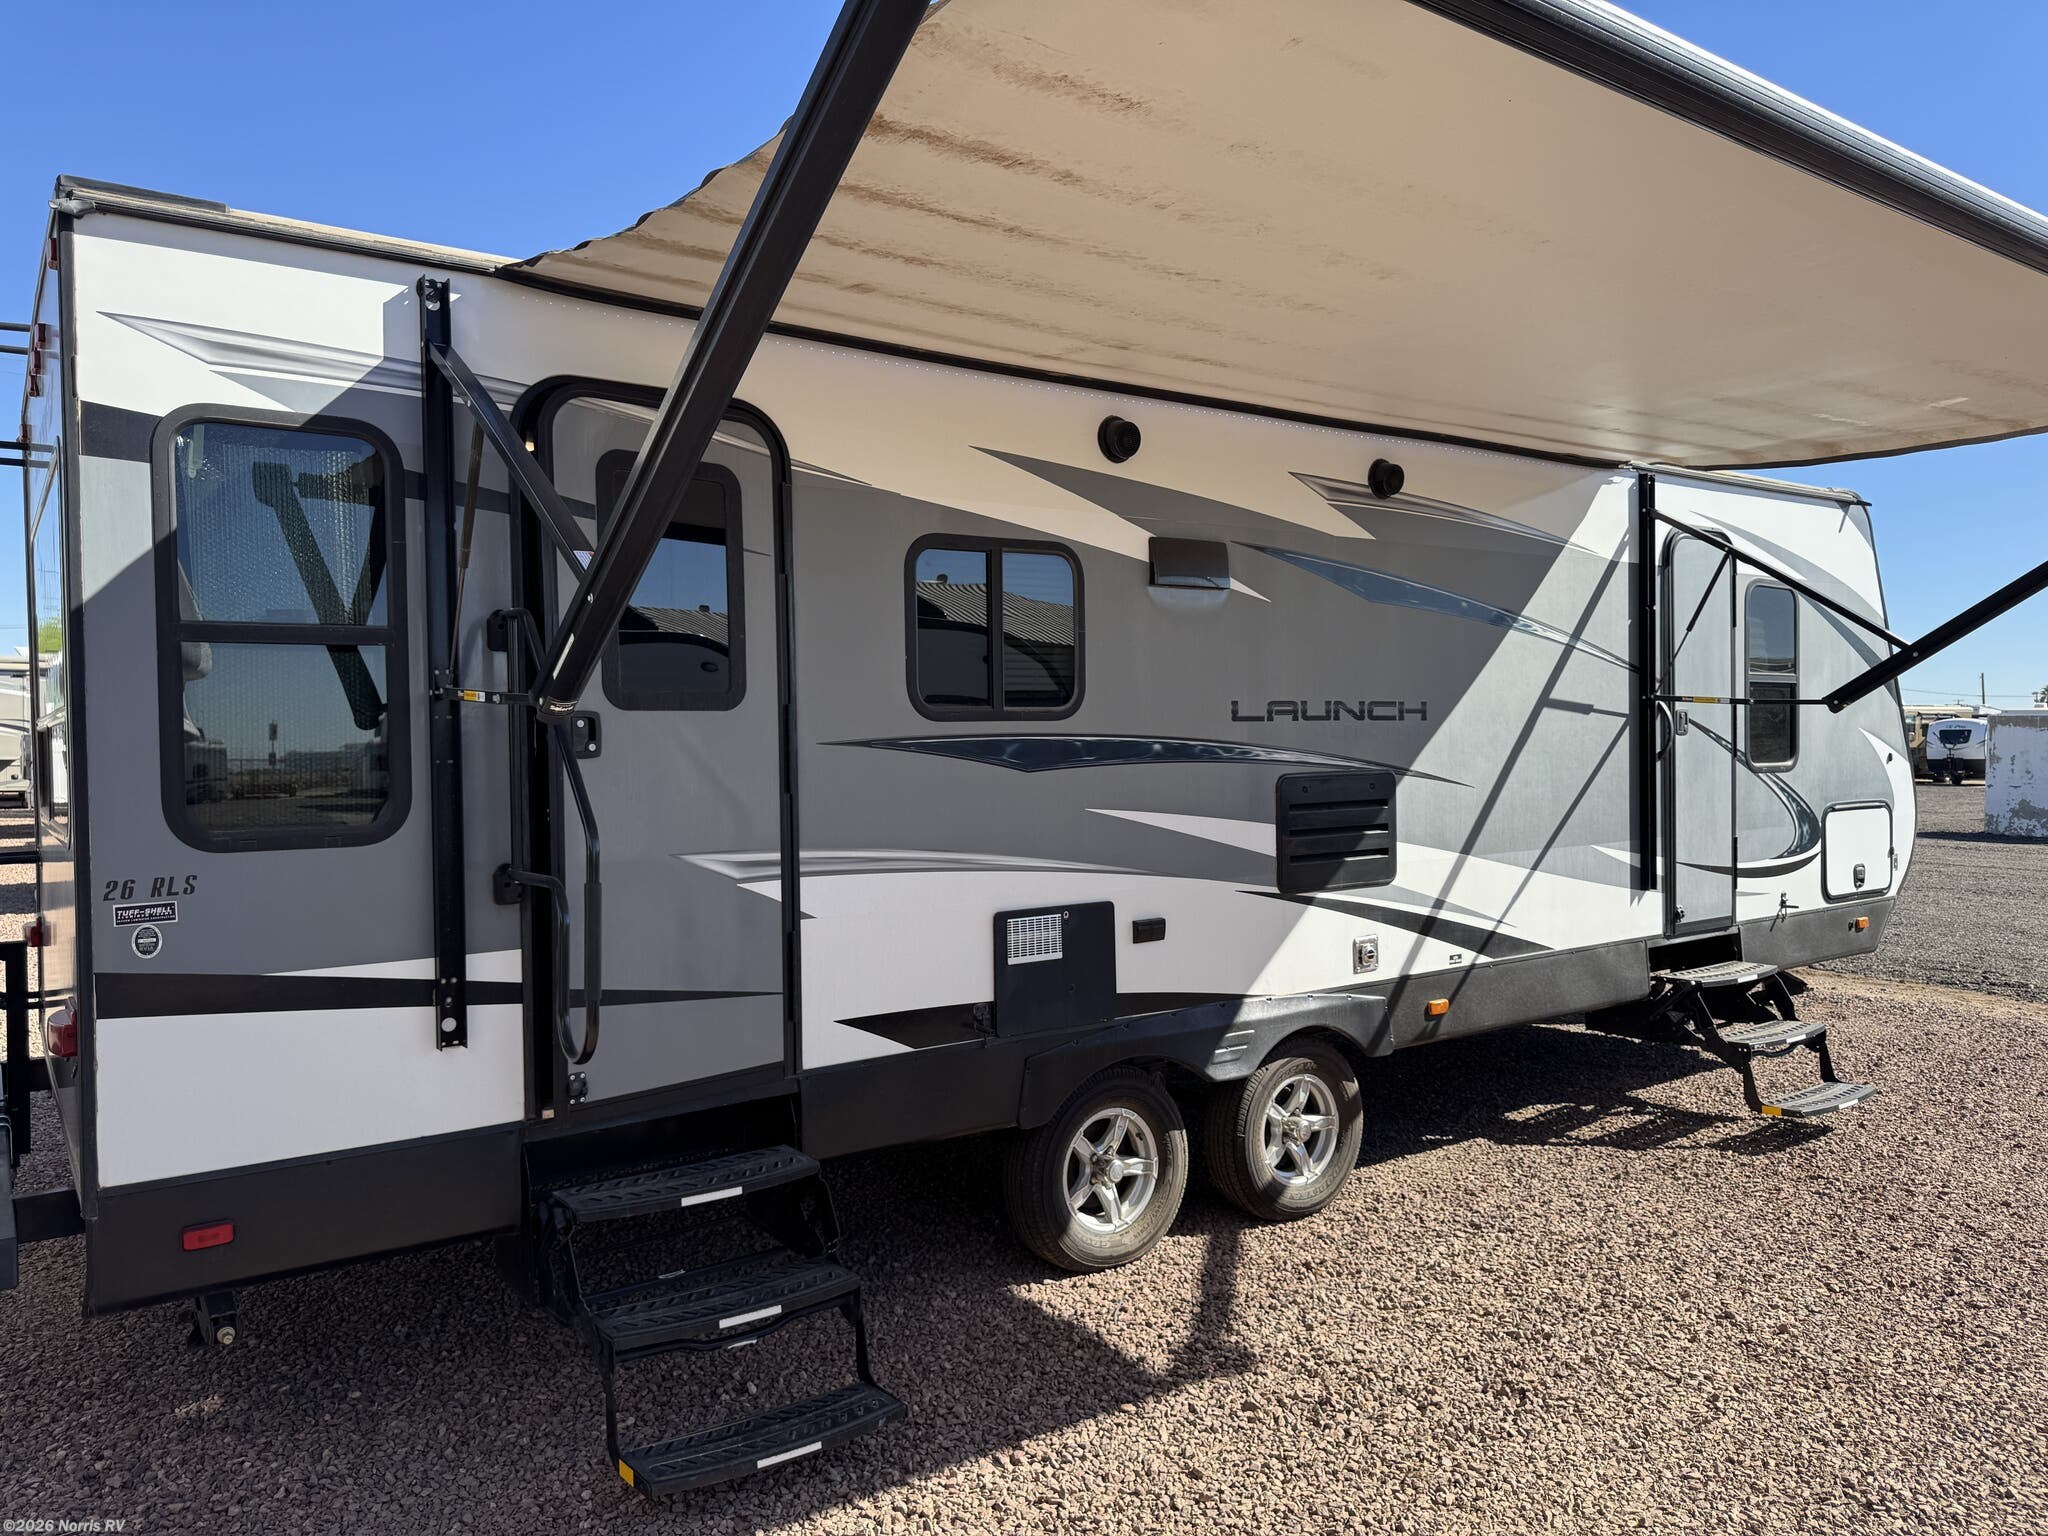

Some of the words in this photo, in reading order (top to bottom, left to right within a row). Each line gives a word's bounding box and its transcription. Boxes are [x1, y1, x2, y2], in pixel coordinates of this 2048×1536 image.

[1231, 700, 1428, 722] LAUNCH
[103, 879, 137, 901] 26
[150, 875, 197, 898] RLS
